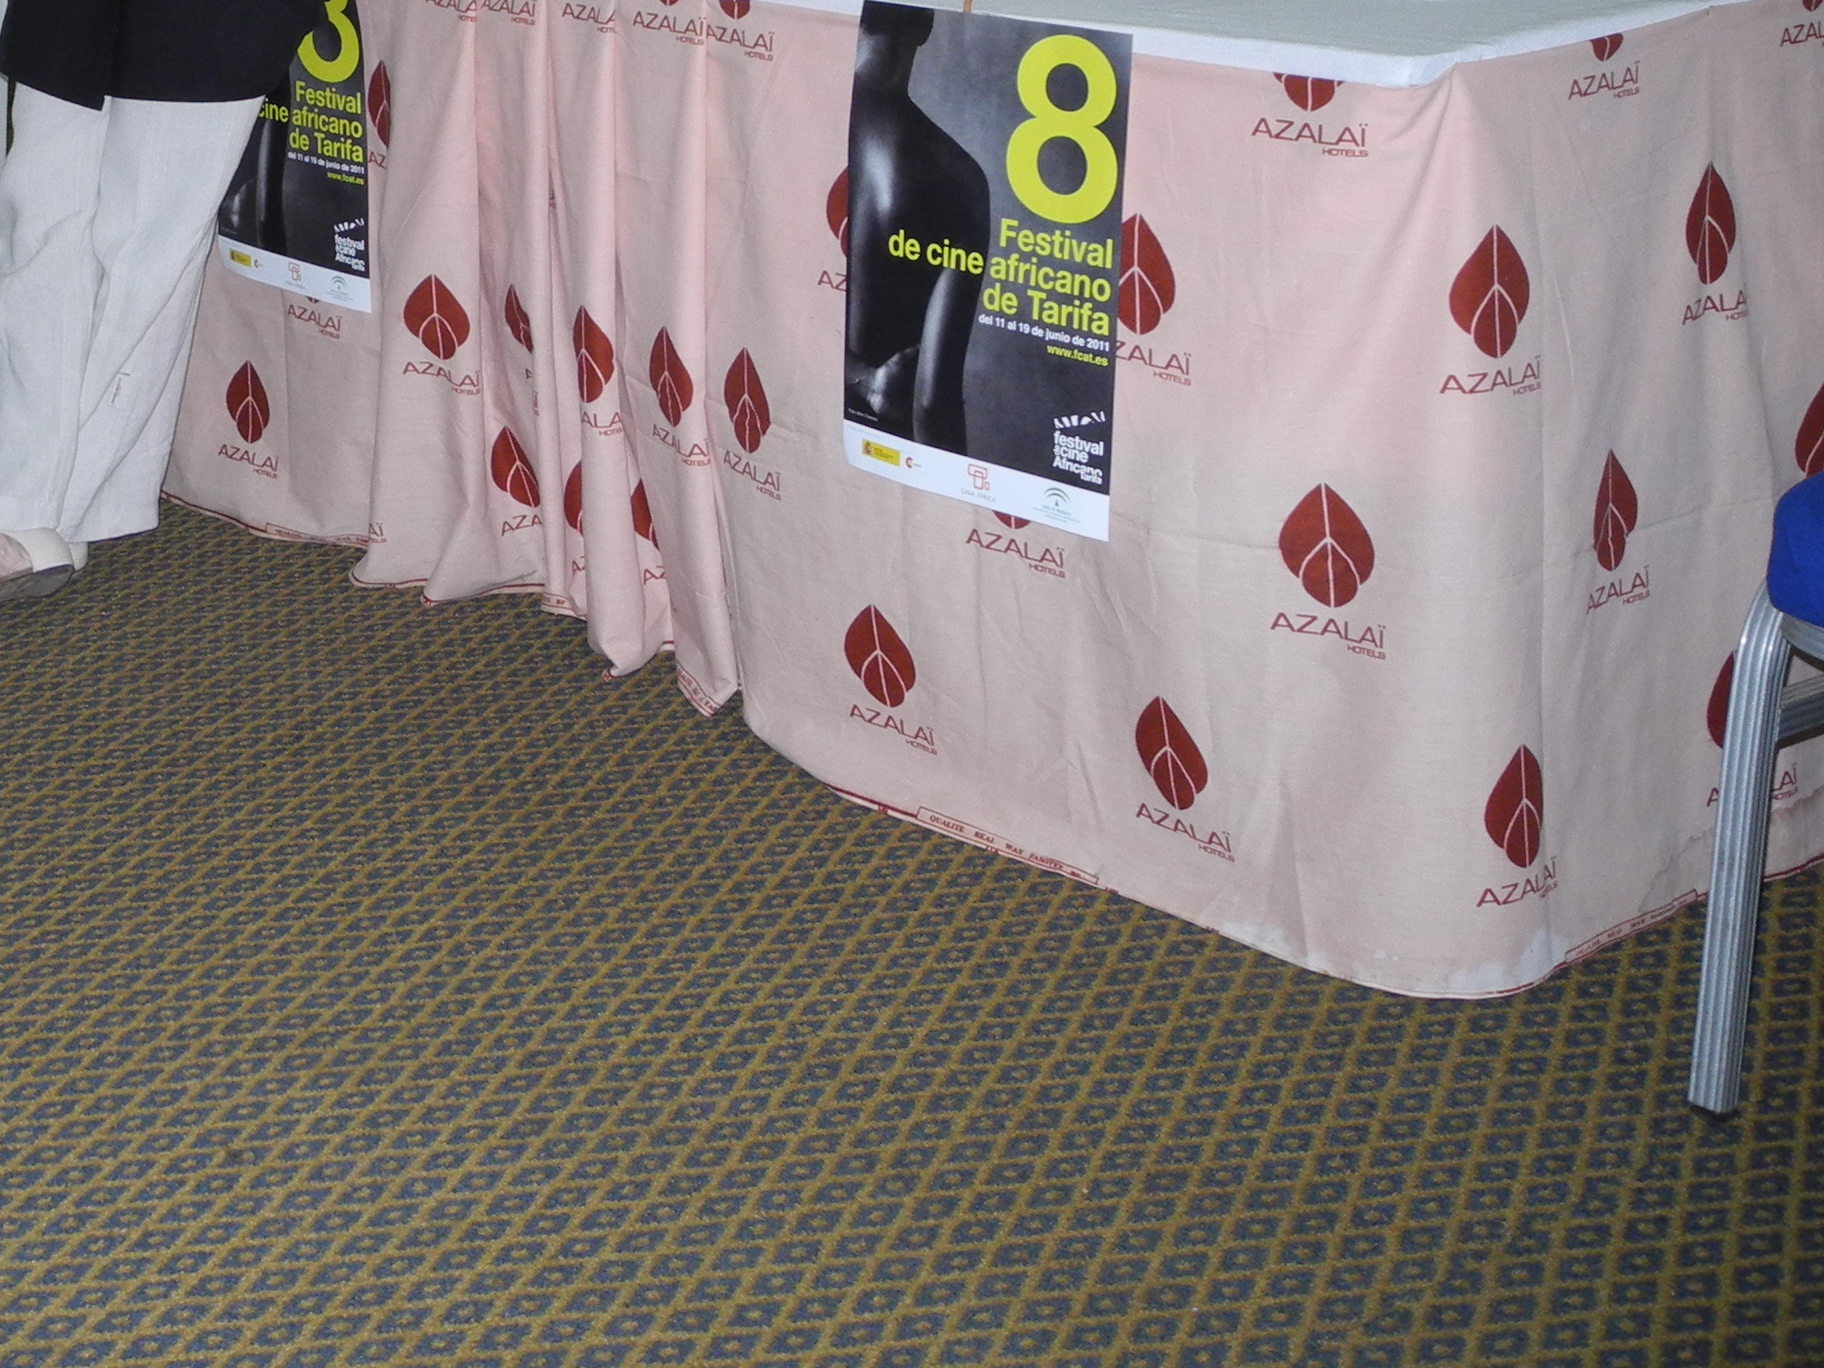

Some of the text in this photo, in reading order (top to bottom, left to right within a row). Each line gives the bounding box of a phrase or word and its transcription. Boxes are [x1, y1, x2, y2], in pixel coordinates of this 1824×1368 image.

[633, 10, 706, 37] AZALAÏ
[295, 80, 362, 114] Festival
[1567, 60, 1641, 100] AZALAÏ
[292, 106, 363, 138] africano
[1005, 34, 1118, 224] 8
[1250, 116, 1369, 148] AZALAÏ
[289, 128, 310, 151] de
[314, 132, 364, 163] Tarifa
[1321, 147, 1369, 158] HOTELS
[999, 218, 1114, 269] Festival
[888, 229, 1112, 302] de cine africano
[983, 283, 1110, 336] de Tarifa
[978, 313, 1110, 352] del 11 al 19 de junio de 2011
[403, 360, 480, 388] AZALAÏ
[1047, 345, 1109, 367] www.fcat.es
[1114, 338, 1192, 377] ZALAÏ
[1153, 370, 1192, 386] HOTELS
[1439, 354, 1542, 395] AZALAÏ
[1053, 430, 1104, 457] festival
[1060, 447, 1089, 463] cine
[723, 450, 781, 491] AZALAÏ
[966, 528, 1065, 570] AZALAÏ
[1028, 562, 1066, 578] HOTELS
[1270, 611, 1387, 649] AZALAÏ
[1346, 644, 1387, 660] HOTELS
[849, 704, 935, 747] AZALAÏ
[1135, 802, 1233, 854] AZALAÏ
